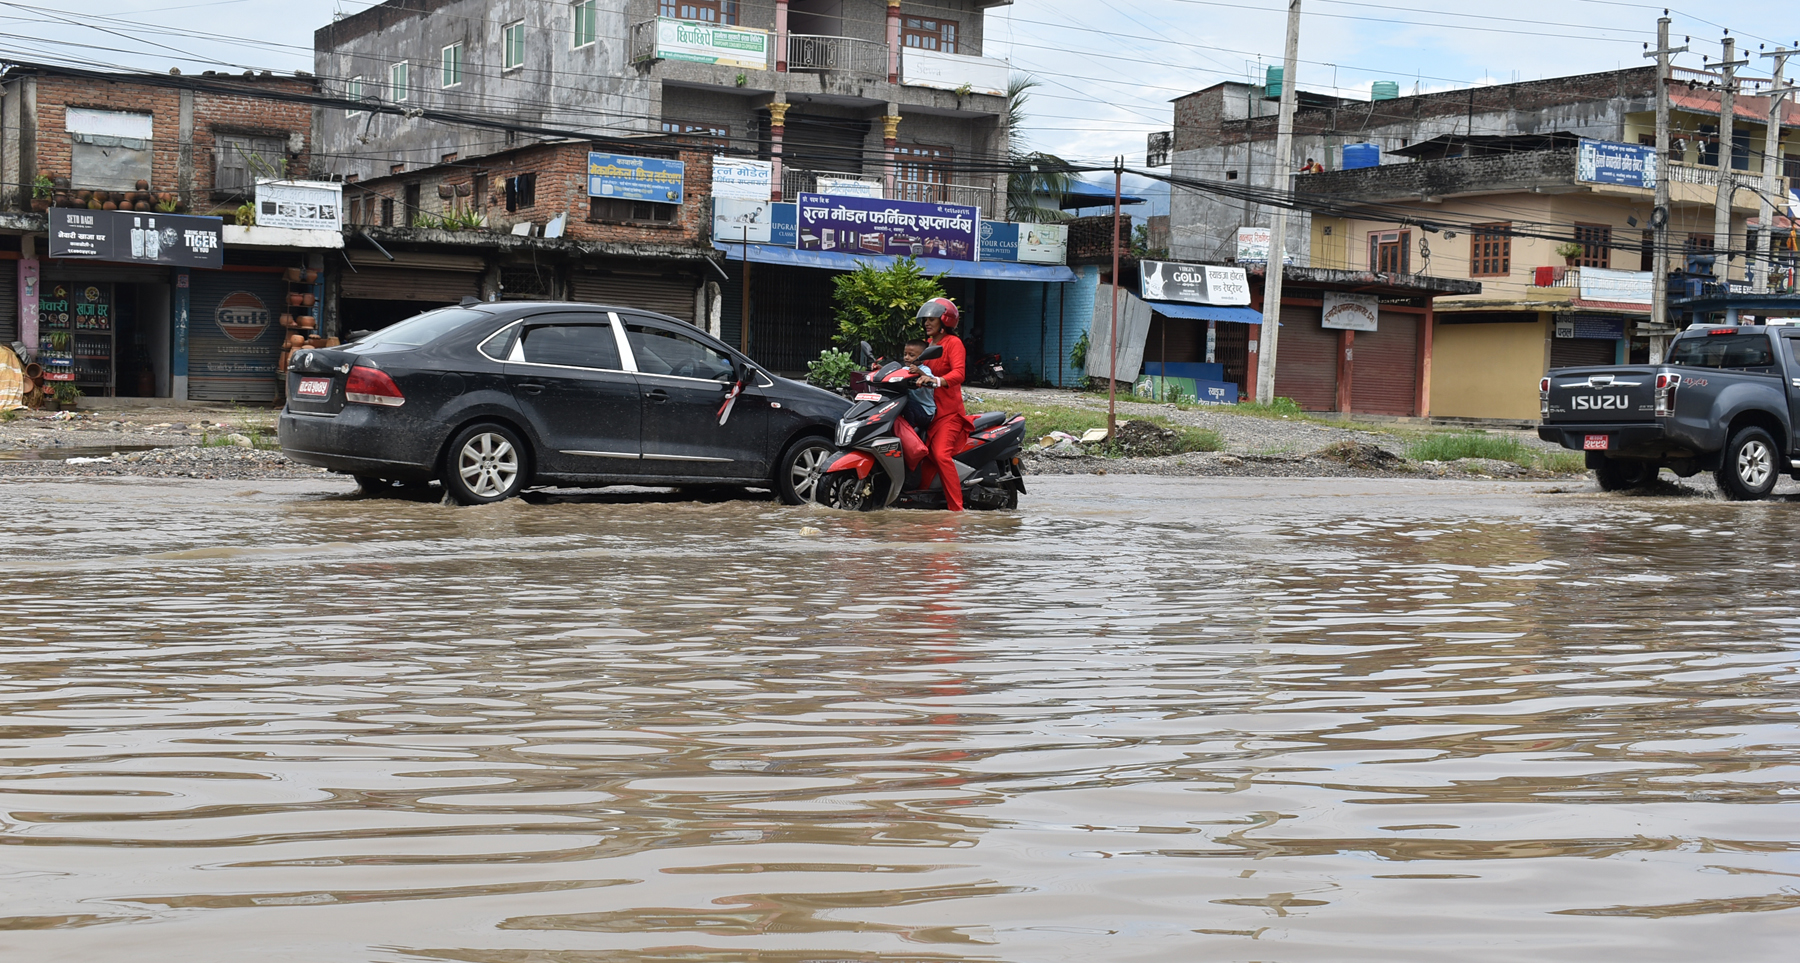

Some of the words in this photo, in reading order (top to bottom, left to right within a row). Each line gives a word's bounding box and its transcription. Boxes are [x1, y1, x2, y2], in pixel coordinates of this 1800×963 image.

[66, 214, 80, 224] SETO
[803, 206, 830, 224] रत्न
[830, 205, 867, 223] मोडल
[870, 208, 919, 232] फर्निचर
[58, 230, 76, 239] नेवारी
[184, 234, 218, 248] TIGER
[1173, 272, 1202, 283] GOLD
[1730, 284, 1742, 293] BIKE
[76, 303, 95, 316] खाजा
[98, 304, 108, 316] घर
[219, 310, 268, 324] Gulf
[218, 346, 270, 354] LUBRICANTS
[207, 362, 232, 372] Quality
[1571, 394, 1629, 410] ISUZU
